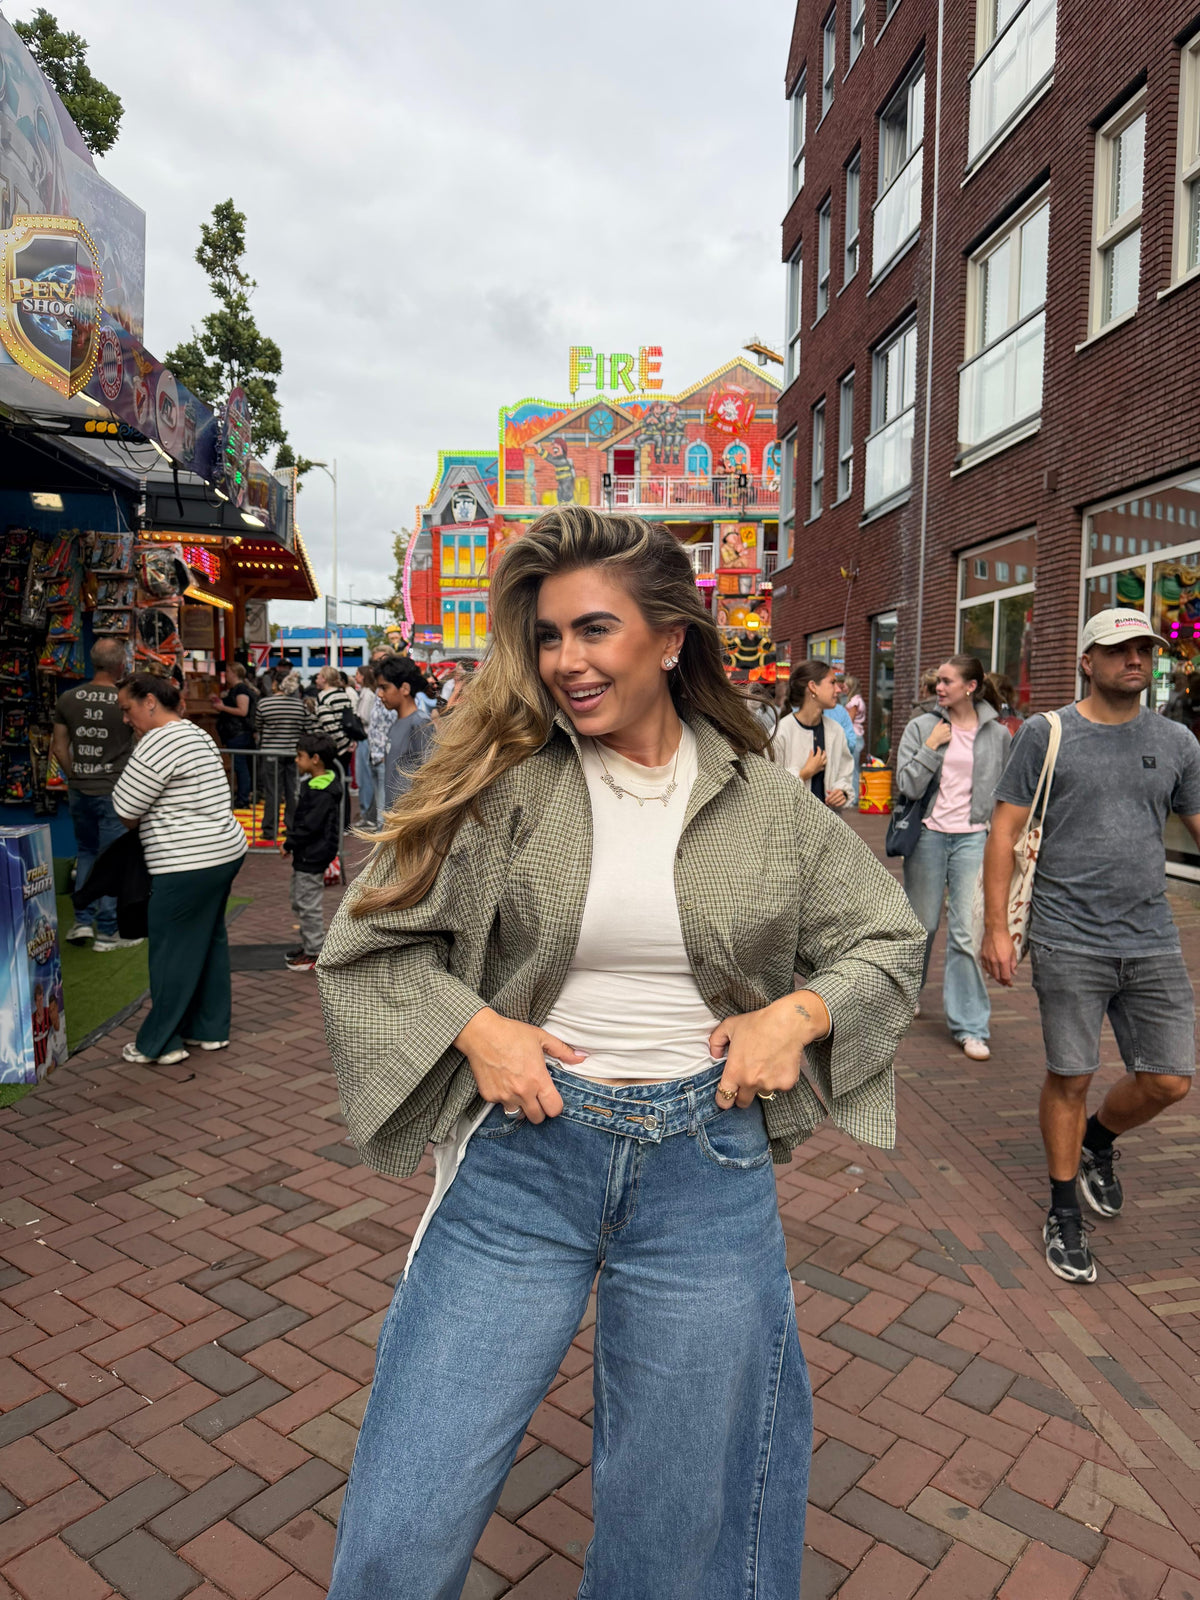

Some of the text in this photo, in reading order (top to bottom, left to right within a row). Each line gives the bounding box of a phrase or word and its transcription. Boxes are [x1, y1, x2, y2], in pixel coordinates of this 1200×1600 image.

[569, 345, 664, 394] FIRE
[75, 690, 118, 704] ONLY
[83, 708, 104, 720] IN
[75, 726, 109, 739] GOD
[78, 744, 104, 757] WE
